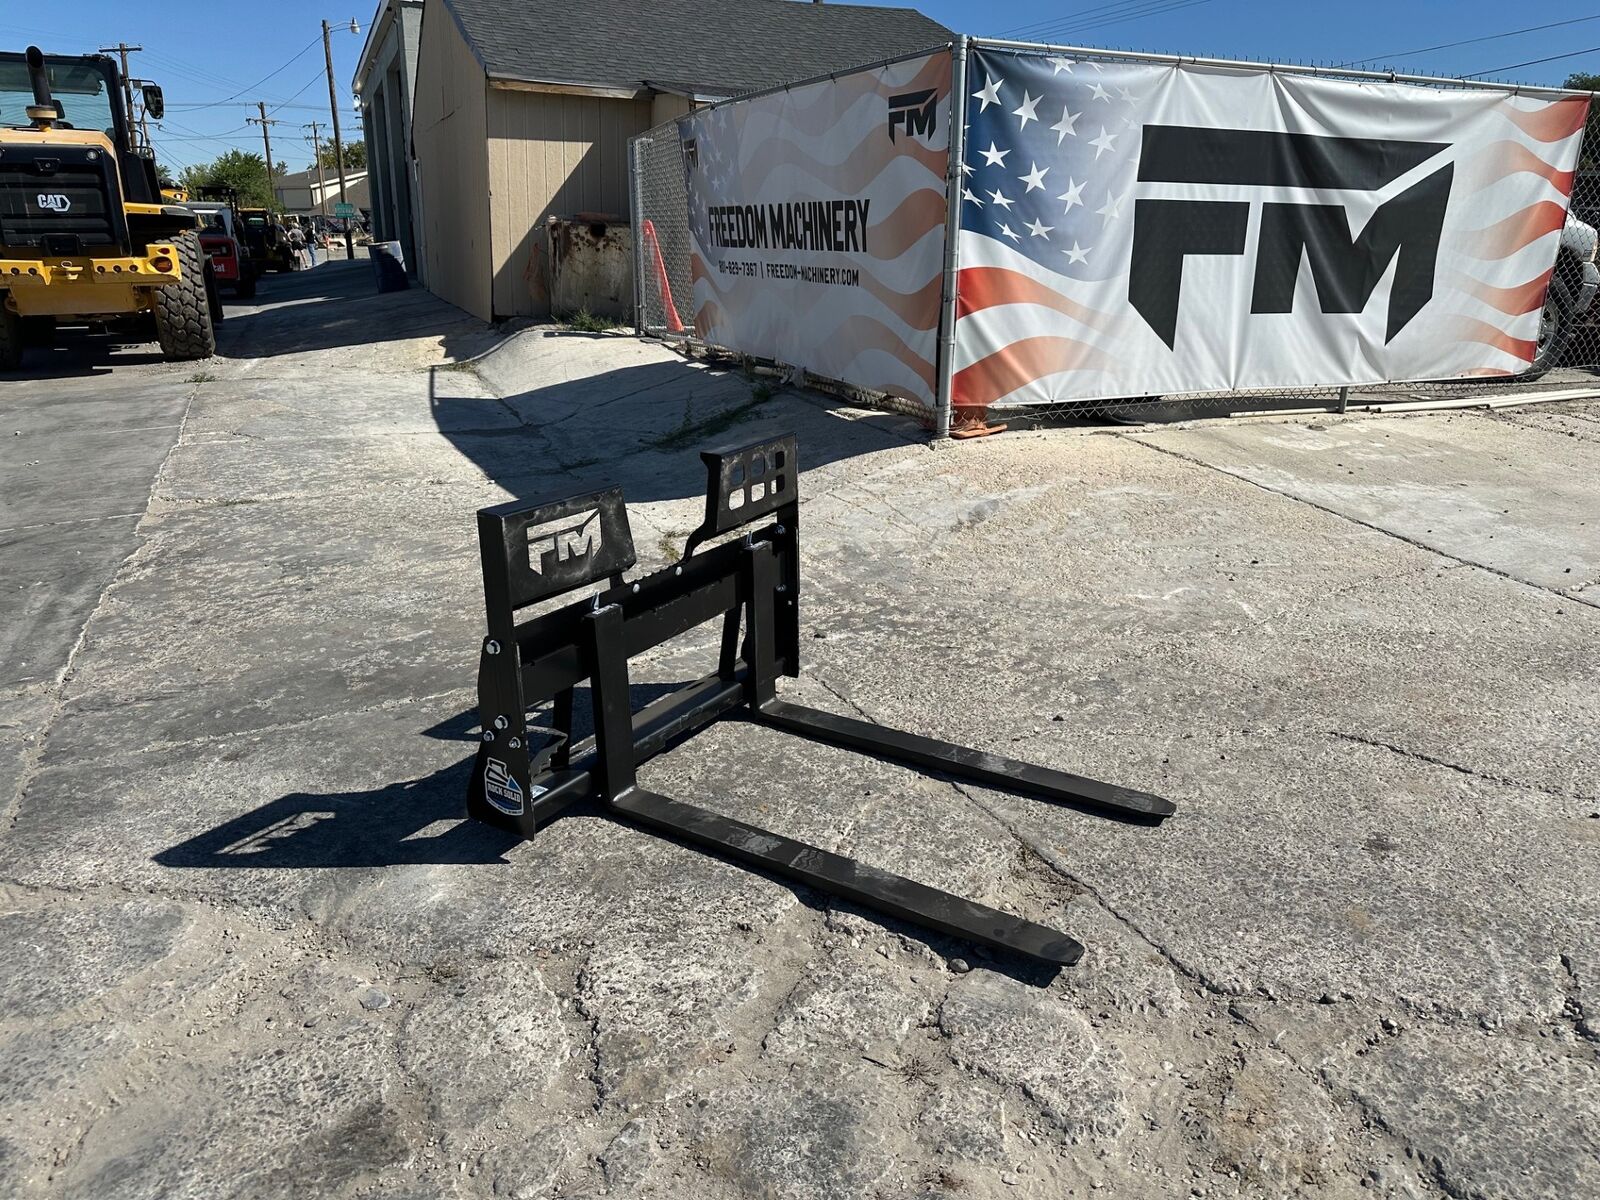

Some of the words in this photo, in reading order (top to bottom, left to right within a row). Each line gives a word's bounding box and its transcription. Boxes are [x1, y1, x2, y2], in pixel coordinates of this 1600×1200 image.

[888, 87, 938, 146] FM
[37, 194, 68, 210] CAT
[708, 204, 768, 249] FREEDOM
[769, 199, 870, 252] MACHINERY
[1128, 124, 1454, 352] FM
[213, 263, 225, 272] cat
[766, 263, 859, 287] FREEDOM-MACHINERY.COM
[526, 507, 602, 575] FM
[503, 789, 521, 803] SOLID
